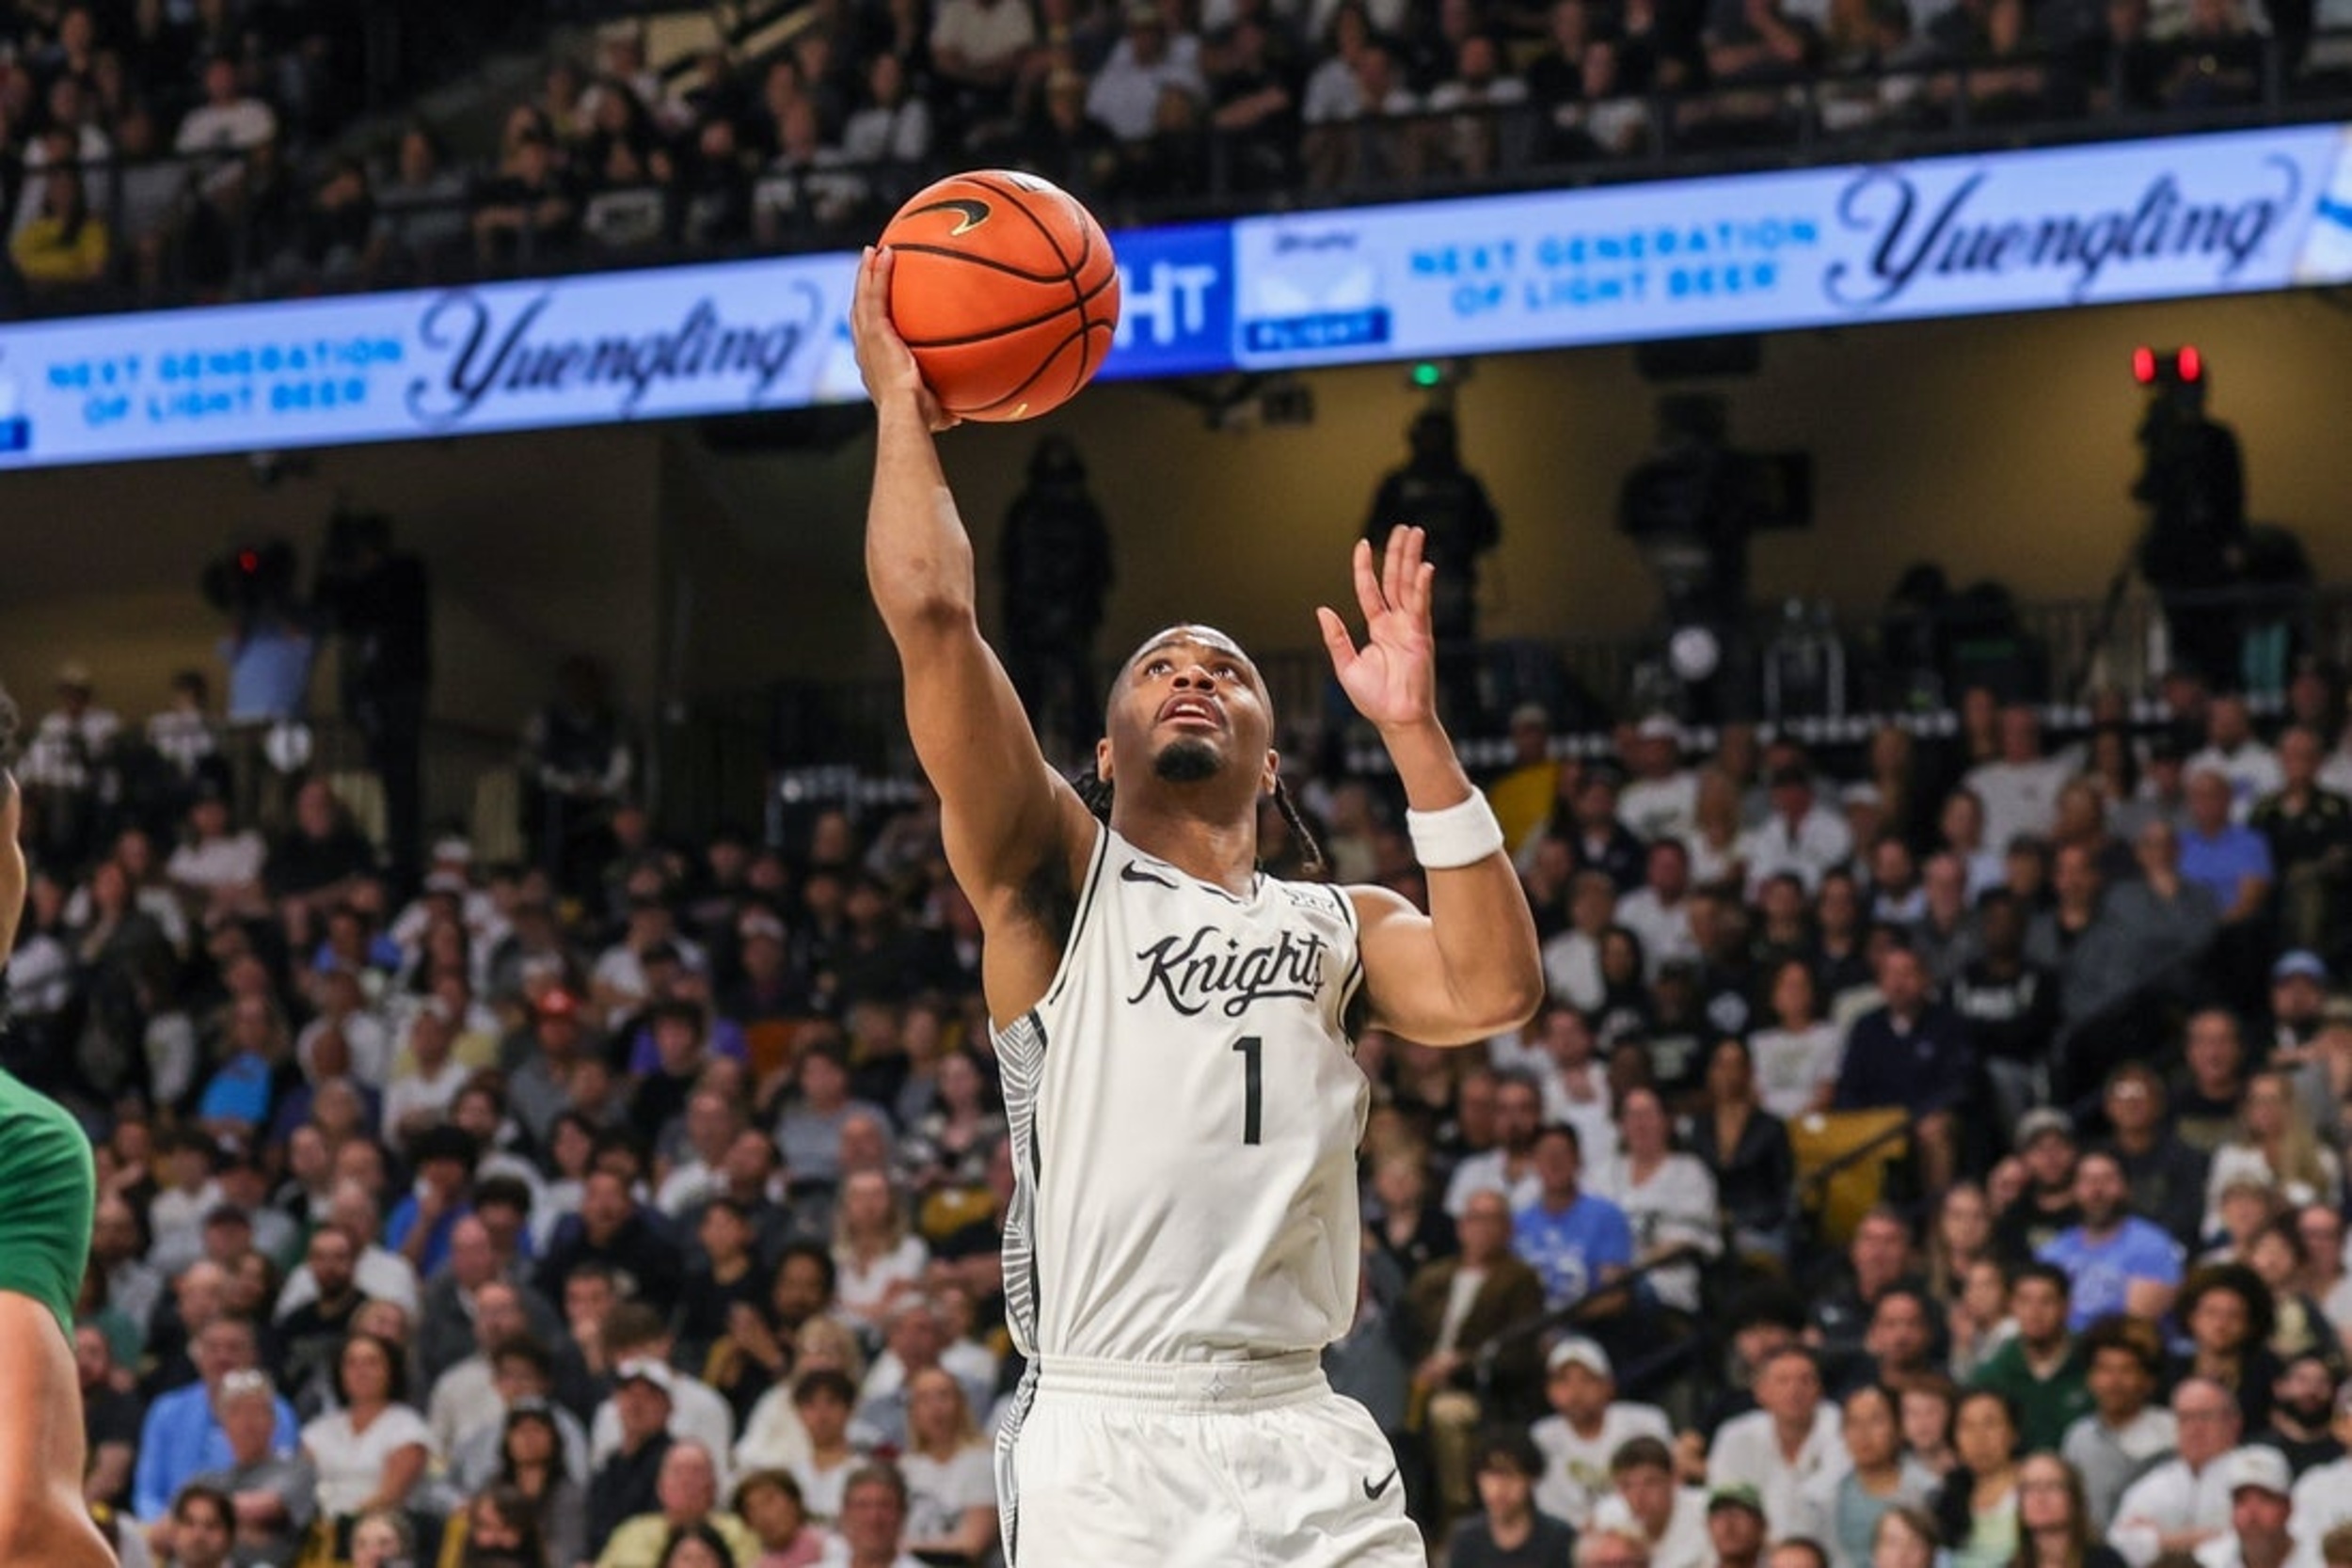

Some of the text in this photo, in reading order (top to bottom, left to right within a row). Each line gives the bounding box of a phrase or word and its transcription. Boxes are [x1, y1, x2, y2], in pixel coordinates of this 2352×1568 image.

[1410, 238, 1516, 275] NEXT
[1537, 217, 1818, 268] GENERATION
[1821, 151, 2303, 309] Yuengling
[1452, 260, 1777, 318] OF LIGHT BEER
[160, 337, 404, 384] GENERATION
[405, 278, 825, 427] Yuengling
[147, 381, 254, 423] LIGHT
[270, 376, 367, 411] BEER
[1232, 1036, 1263, 1146] 1
